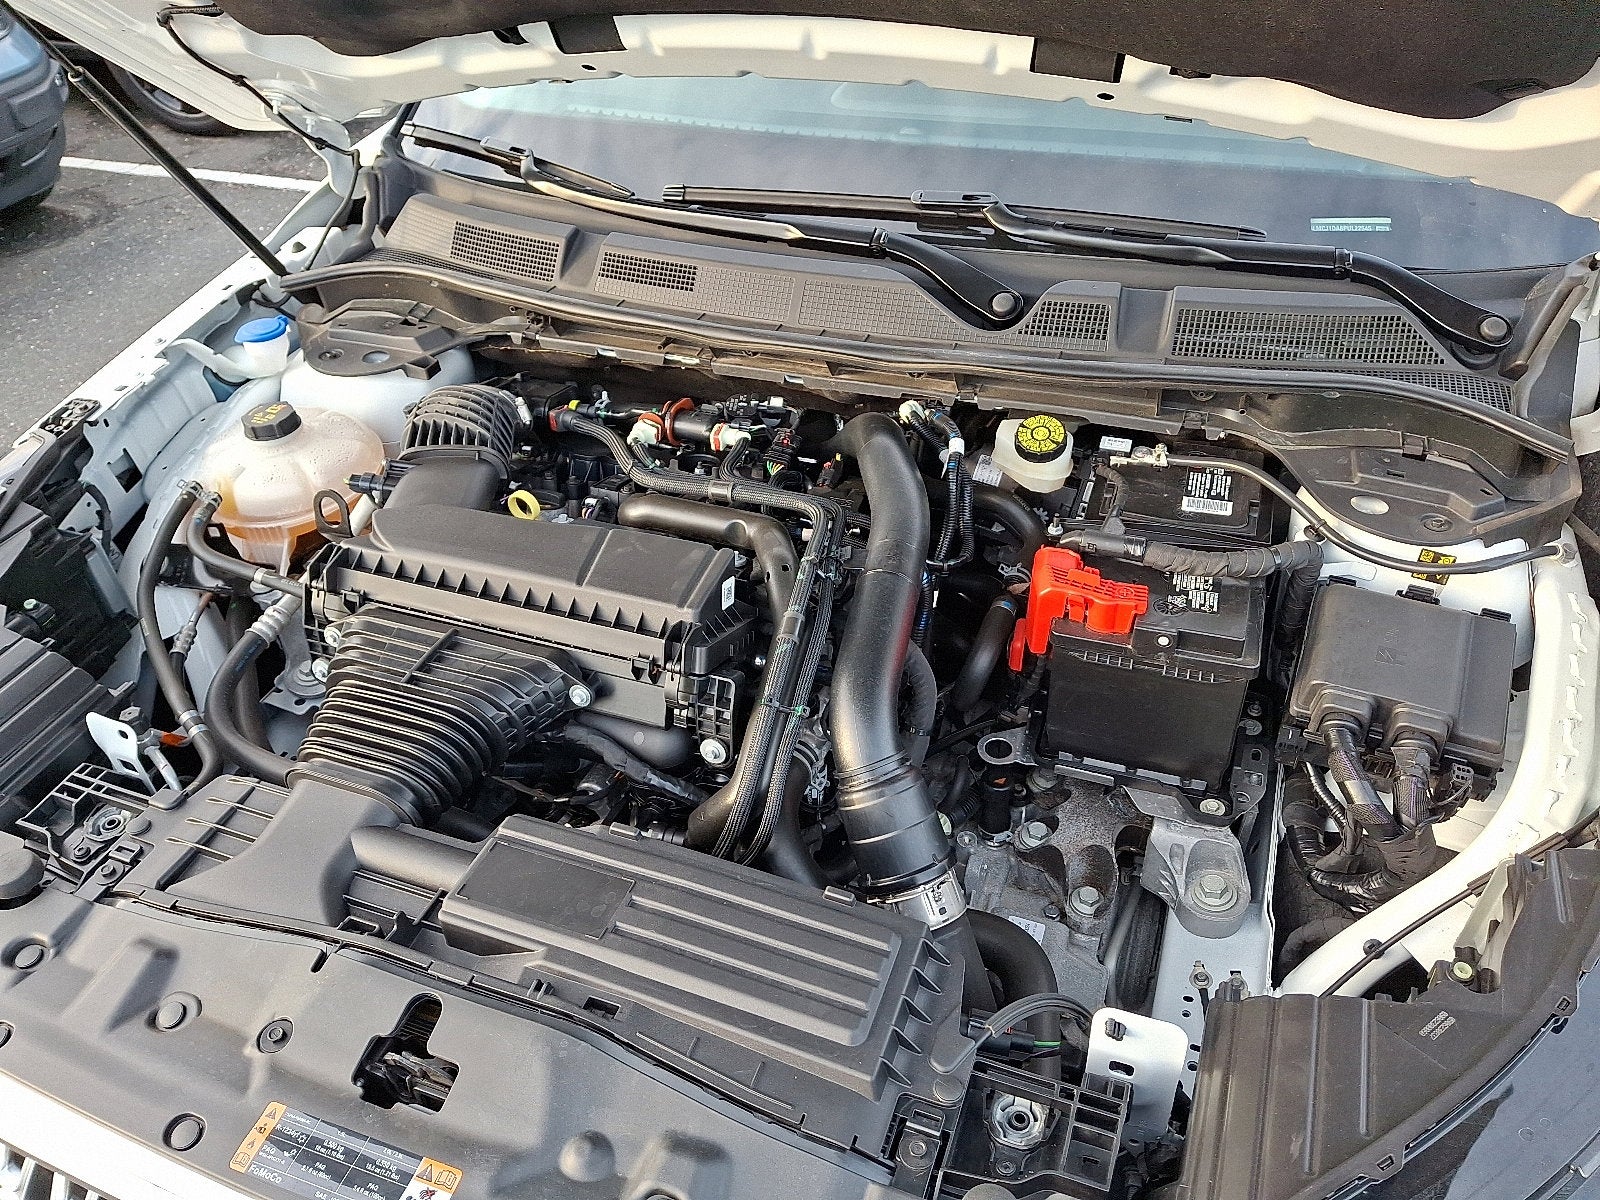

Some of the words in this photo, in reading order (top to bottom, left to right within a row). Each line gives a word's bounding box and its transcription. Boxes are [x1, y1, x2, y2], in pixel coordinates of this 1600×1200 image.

[275, 1125, 301, 1139] R-1234yf
[337, 1145, 344, 1153] kg
[315, 1162, 326, 1170] PAG
[390, 1163, 397, 1172] kg
[248, 1164, 282, 1183] FoMoCo
[367, 1183, 379, 1191] PAG
